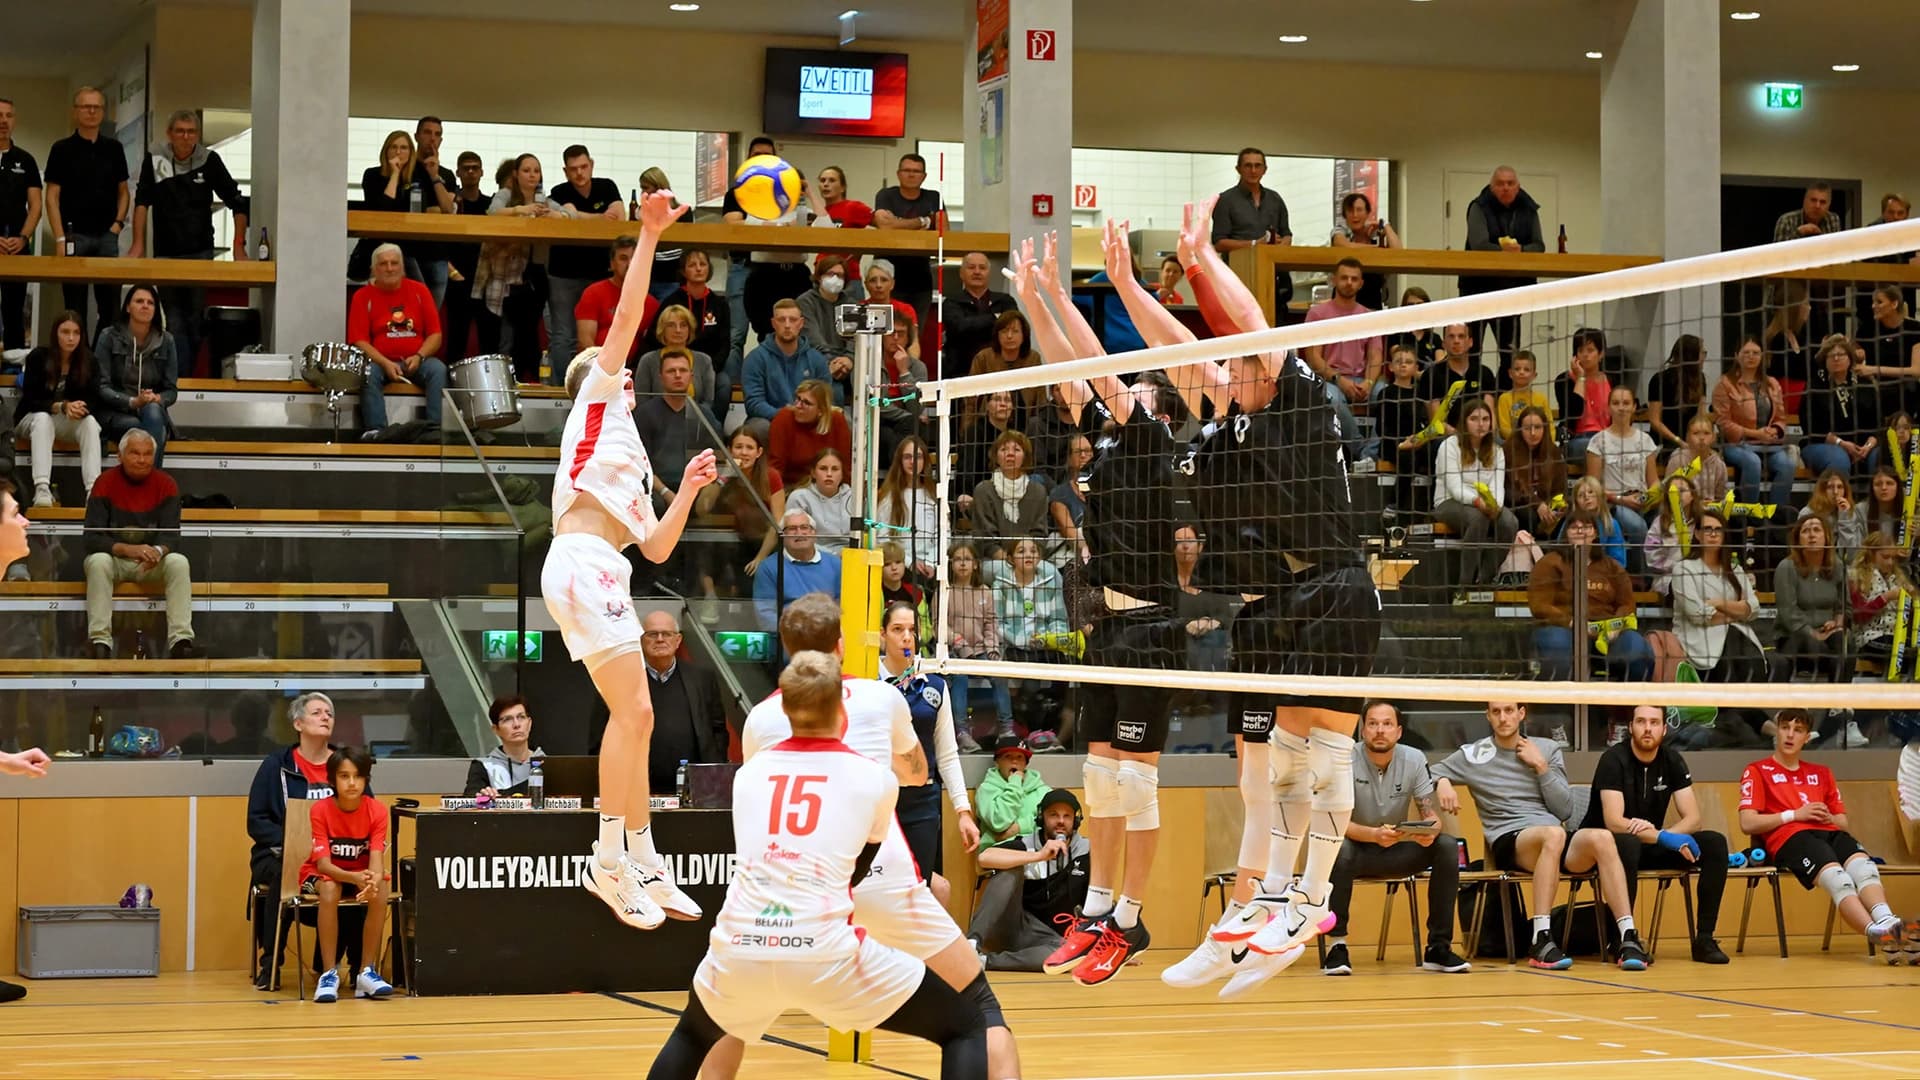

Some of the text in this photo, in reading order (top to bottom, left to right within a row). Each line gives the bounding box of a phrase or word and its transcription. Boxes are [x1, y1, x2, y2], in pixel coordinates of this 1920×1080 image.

[802, 68, 871, 92] ZWETTL
[274, 680, 280, 688] 7
[373, 680, 378, 688] 6
[768, 774, 828, 837] 15
[731, 934, 815, 948] GERIDOOR
